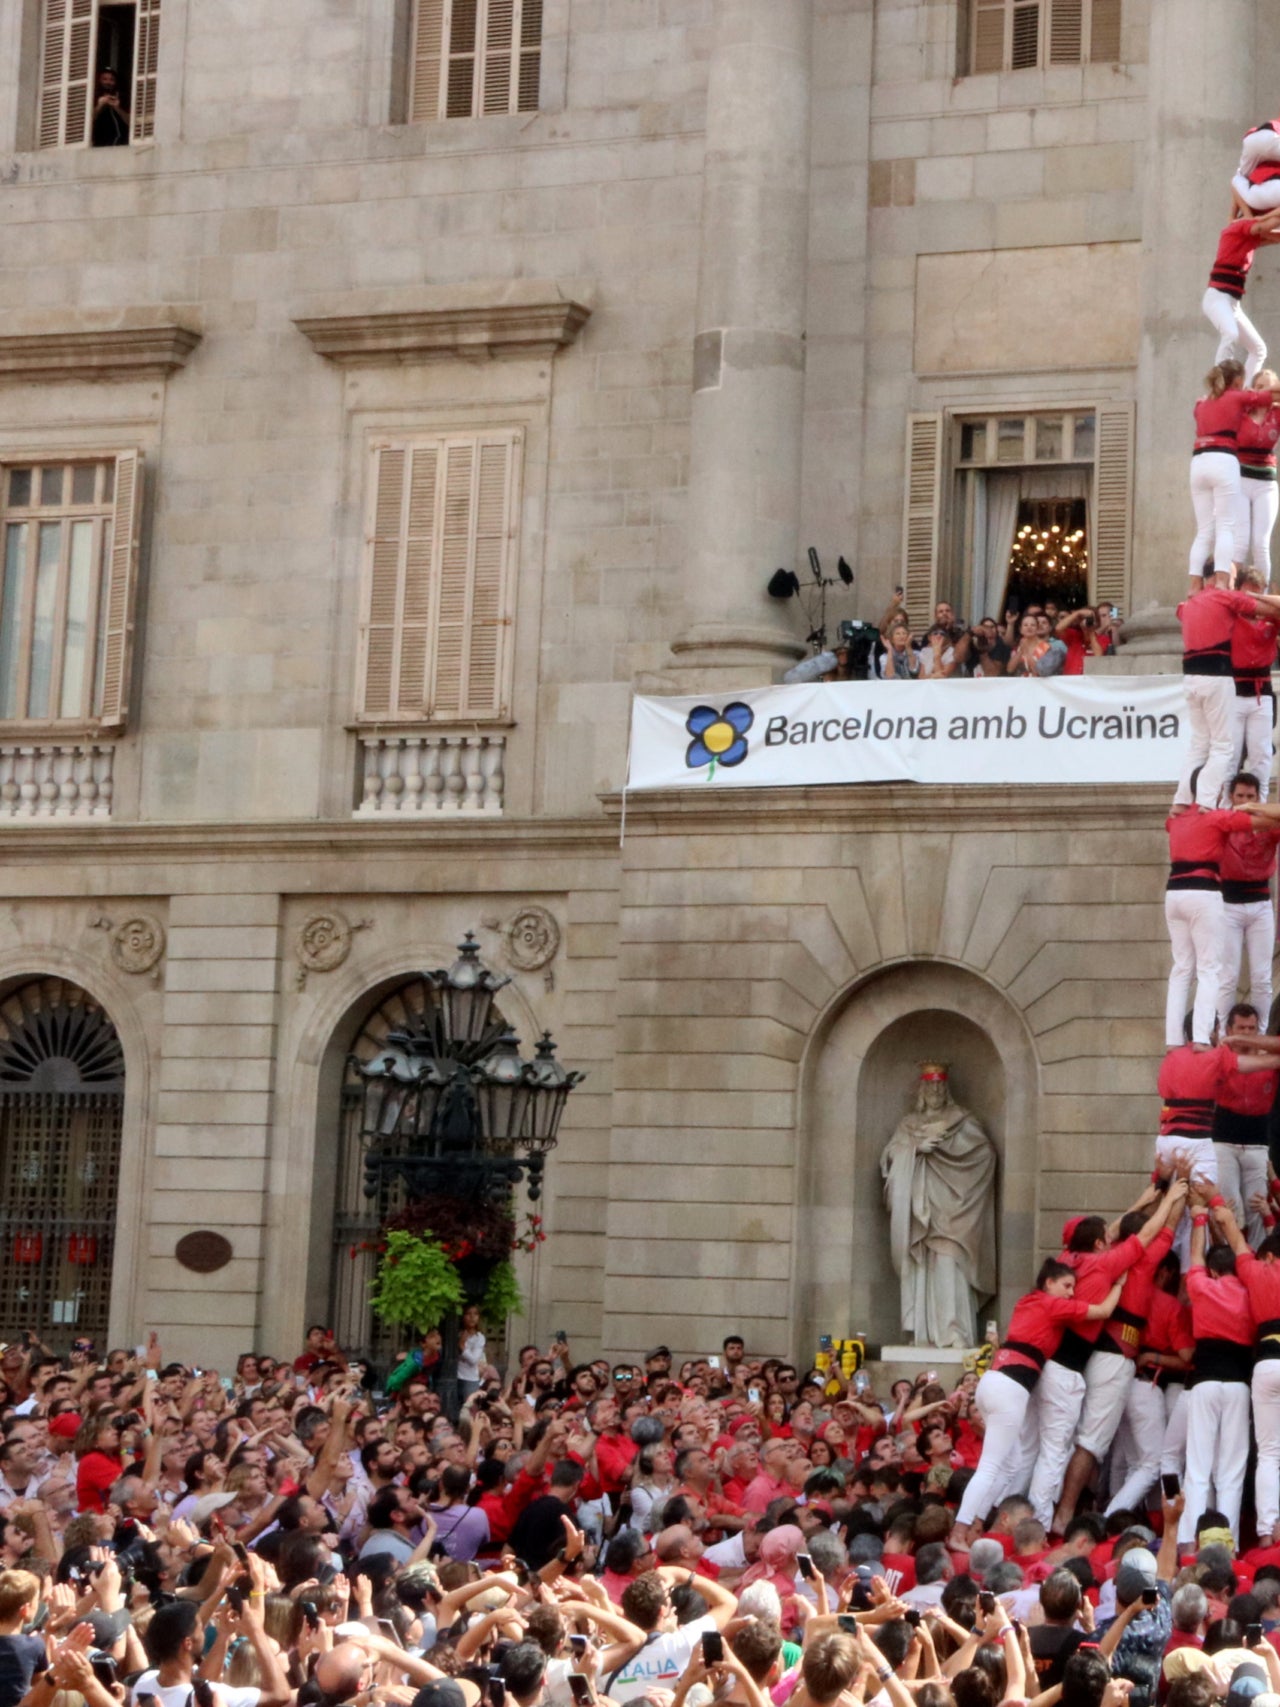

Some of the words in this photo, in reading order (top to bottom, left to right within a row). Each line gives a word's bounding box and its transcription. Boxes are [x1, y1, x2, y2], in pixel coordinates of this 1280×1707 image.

[764, 709, 938, 746] Barcelona
[947, 705, 1028, 740] amb
[1037, 706, 1180, 740] Ucraïna
[617, 1658, 679, 1678] TALIA
